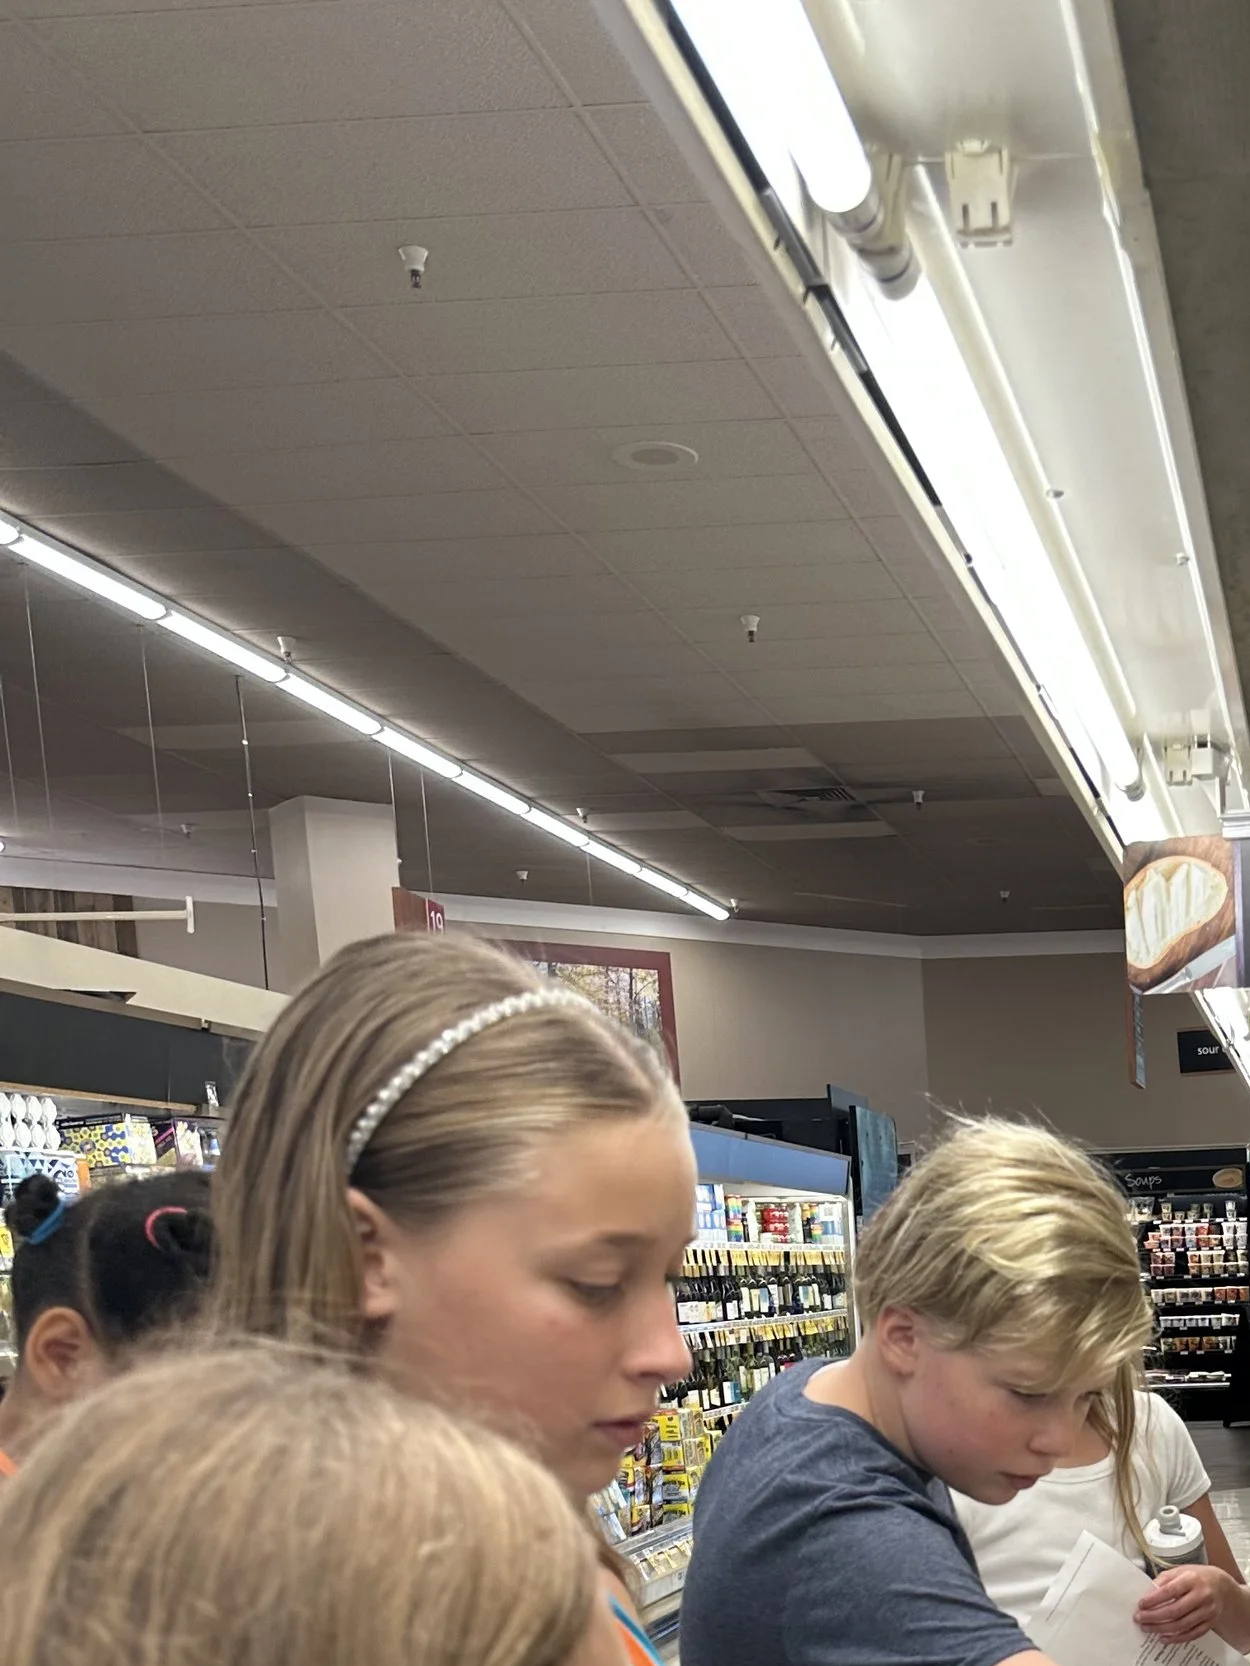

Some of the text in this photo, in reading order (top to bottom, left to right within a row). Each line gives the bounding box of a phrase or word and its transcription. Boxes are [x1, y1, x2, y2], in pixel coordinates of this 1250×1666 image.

[430, 910, 444, 933] 19
[1197, 1045, 1220, 1056] sour
[1124, 1173, 1162, 1190] Soups
